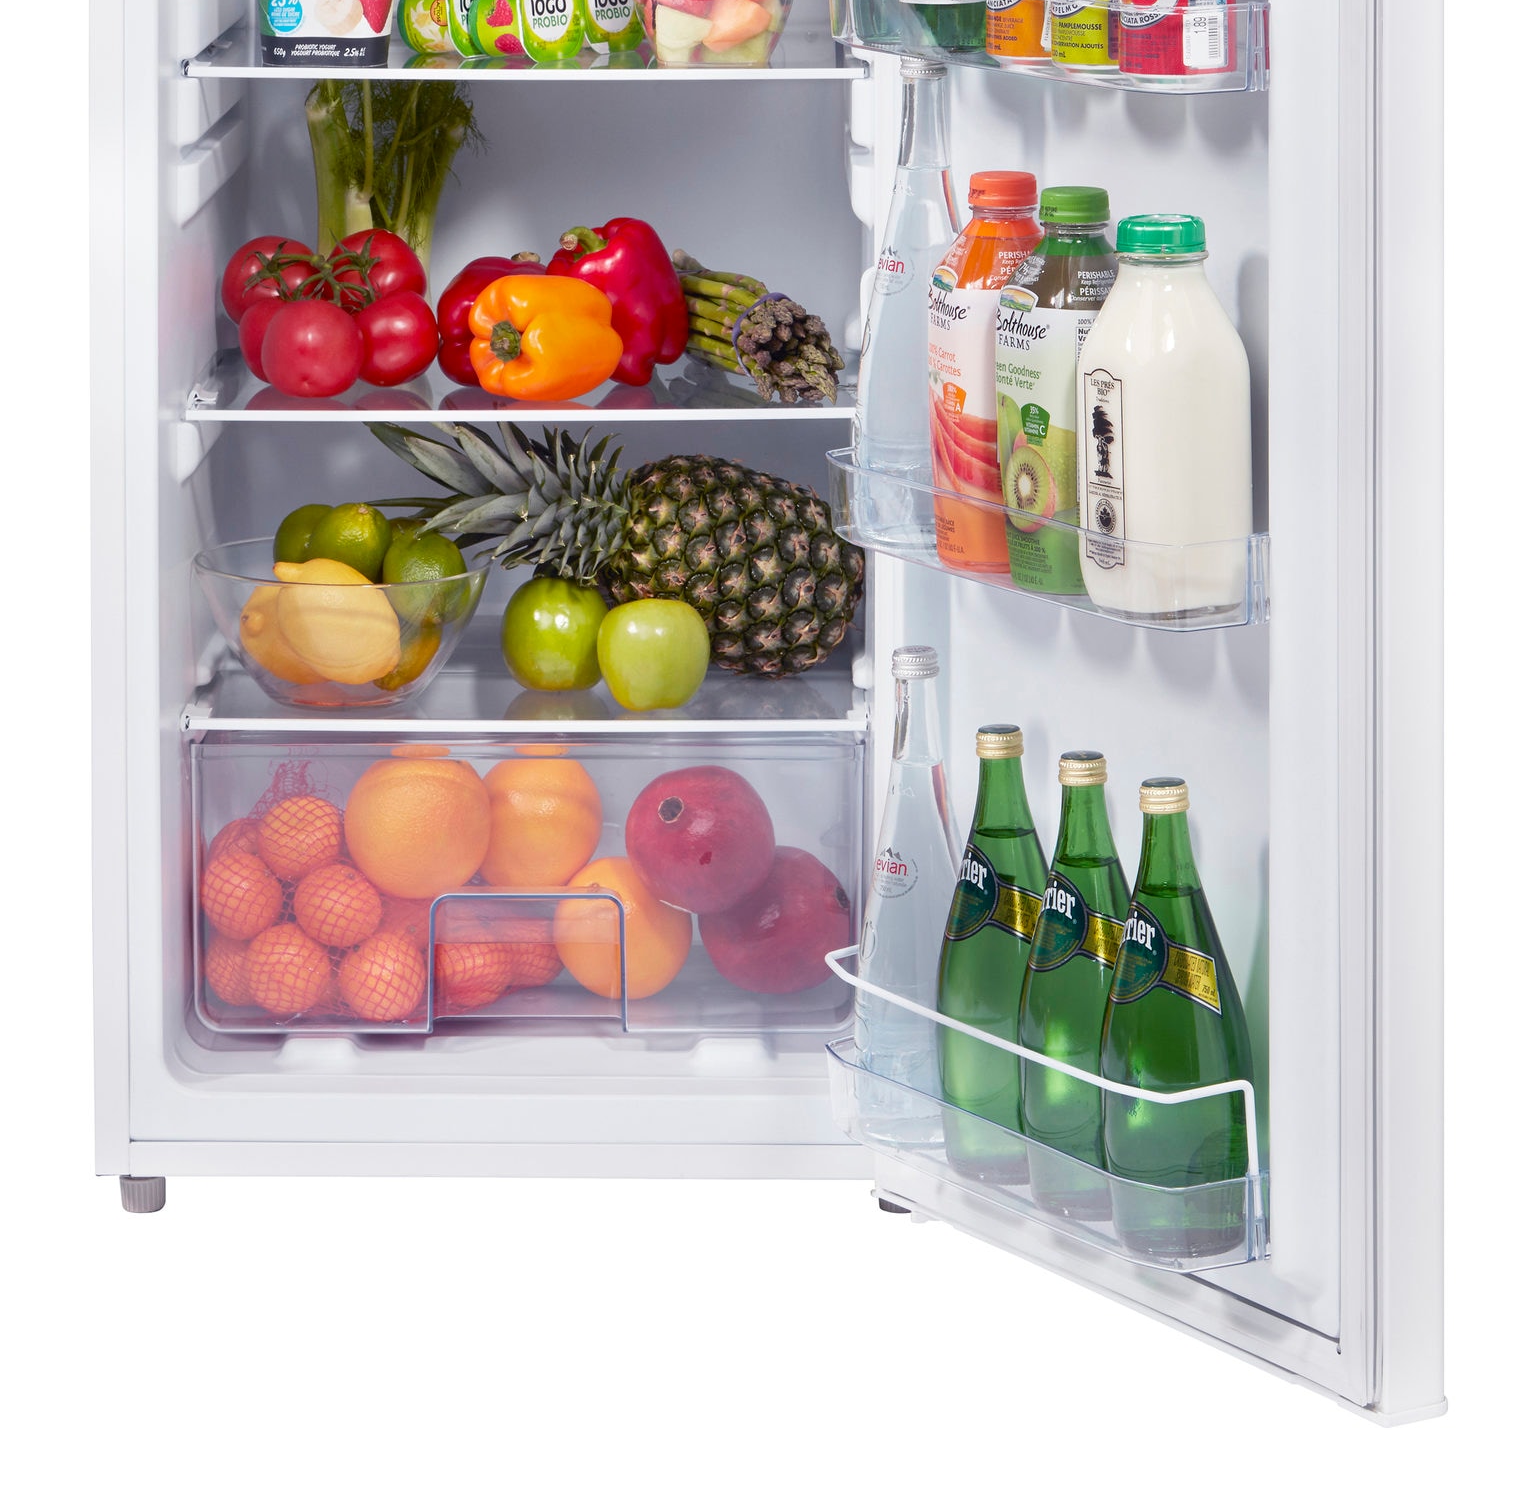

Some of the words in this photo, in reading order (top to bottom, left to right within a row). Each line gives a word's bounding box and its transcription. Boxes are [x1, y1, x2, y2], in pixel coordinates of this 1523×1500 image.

[595, 6, 630, 21] PROBIO
[533, 14, 568, 29] PROBIO
[1058, 22, 1102, 31] PAMPLEMOUSSE
[1193, 16, 1207, 34] 1.89
[998, 251, 1031, 260] PERISH
[877, 256, 905, 274] evian
[1077, 270, 1116, 280] PERISHABLE
[1079, 285, 1111, 296] PÉRISSA
[930, 312, 951, 331] FARMS
[997, 307, 1047, 340] Bolthouse
[998, 333, 1031, 351] FARMS
[938, 347, 956, 363] Carrot
[937, 360, 961, 377] Carottes
[996, 361, 1007, 373] een
[1007, 363, 1040, 380] Goodness
[1014, 376, 1034, 391] Verte
[1090, 378, 1100, 388] LES
[1039, 424, 1046, 436] C
[876, 857, 909, 877] evian
